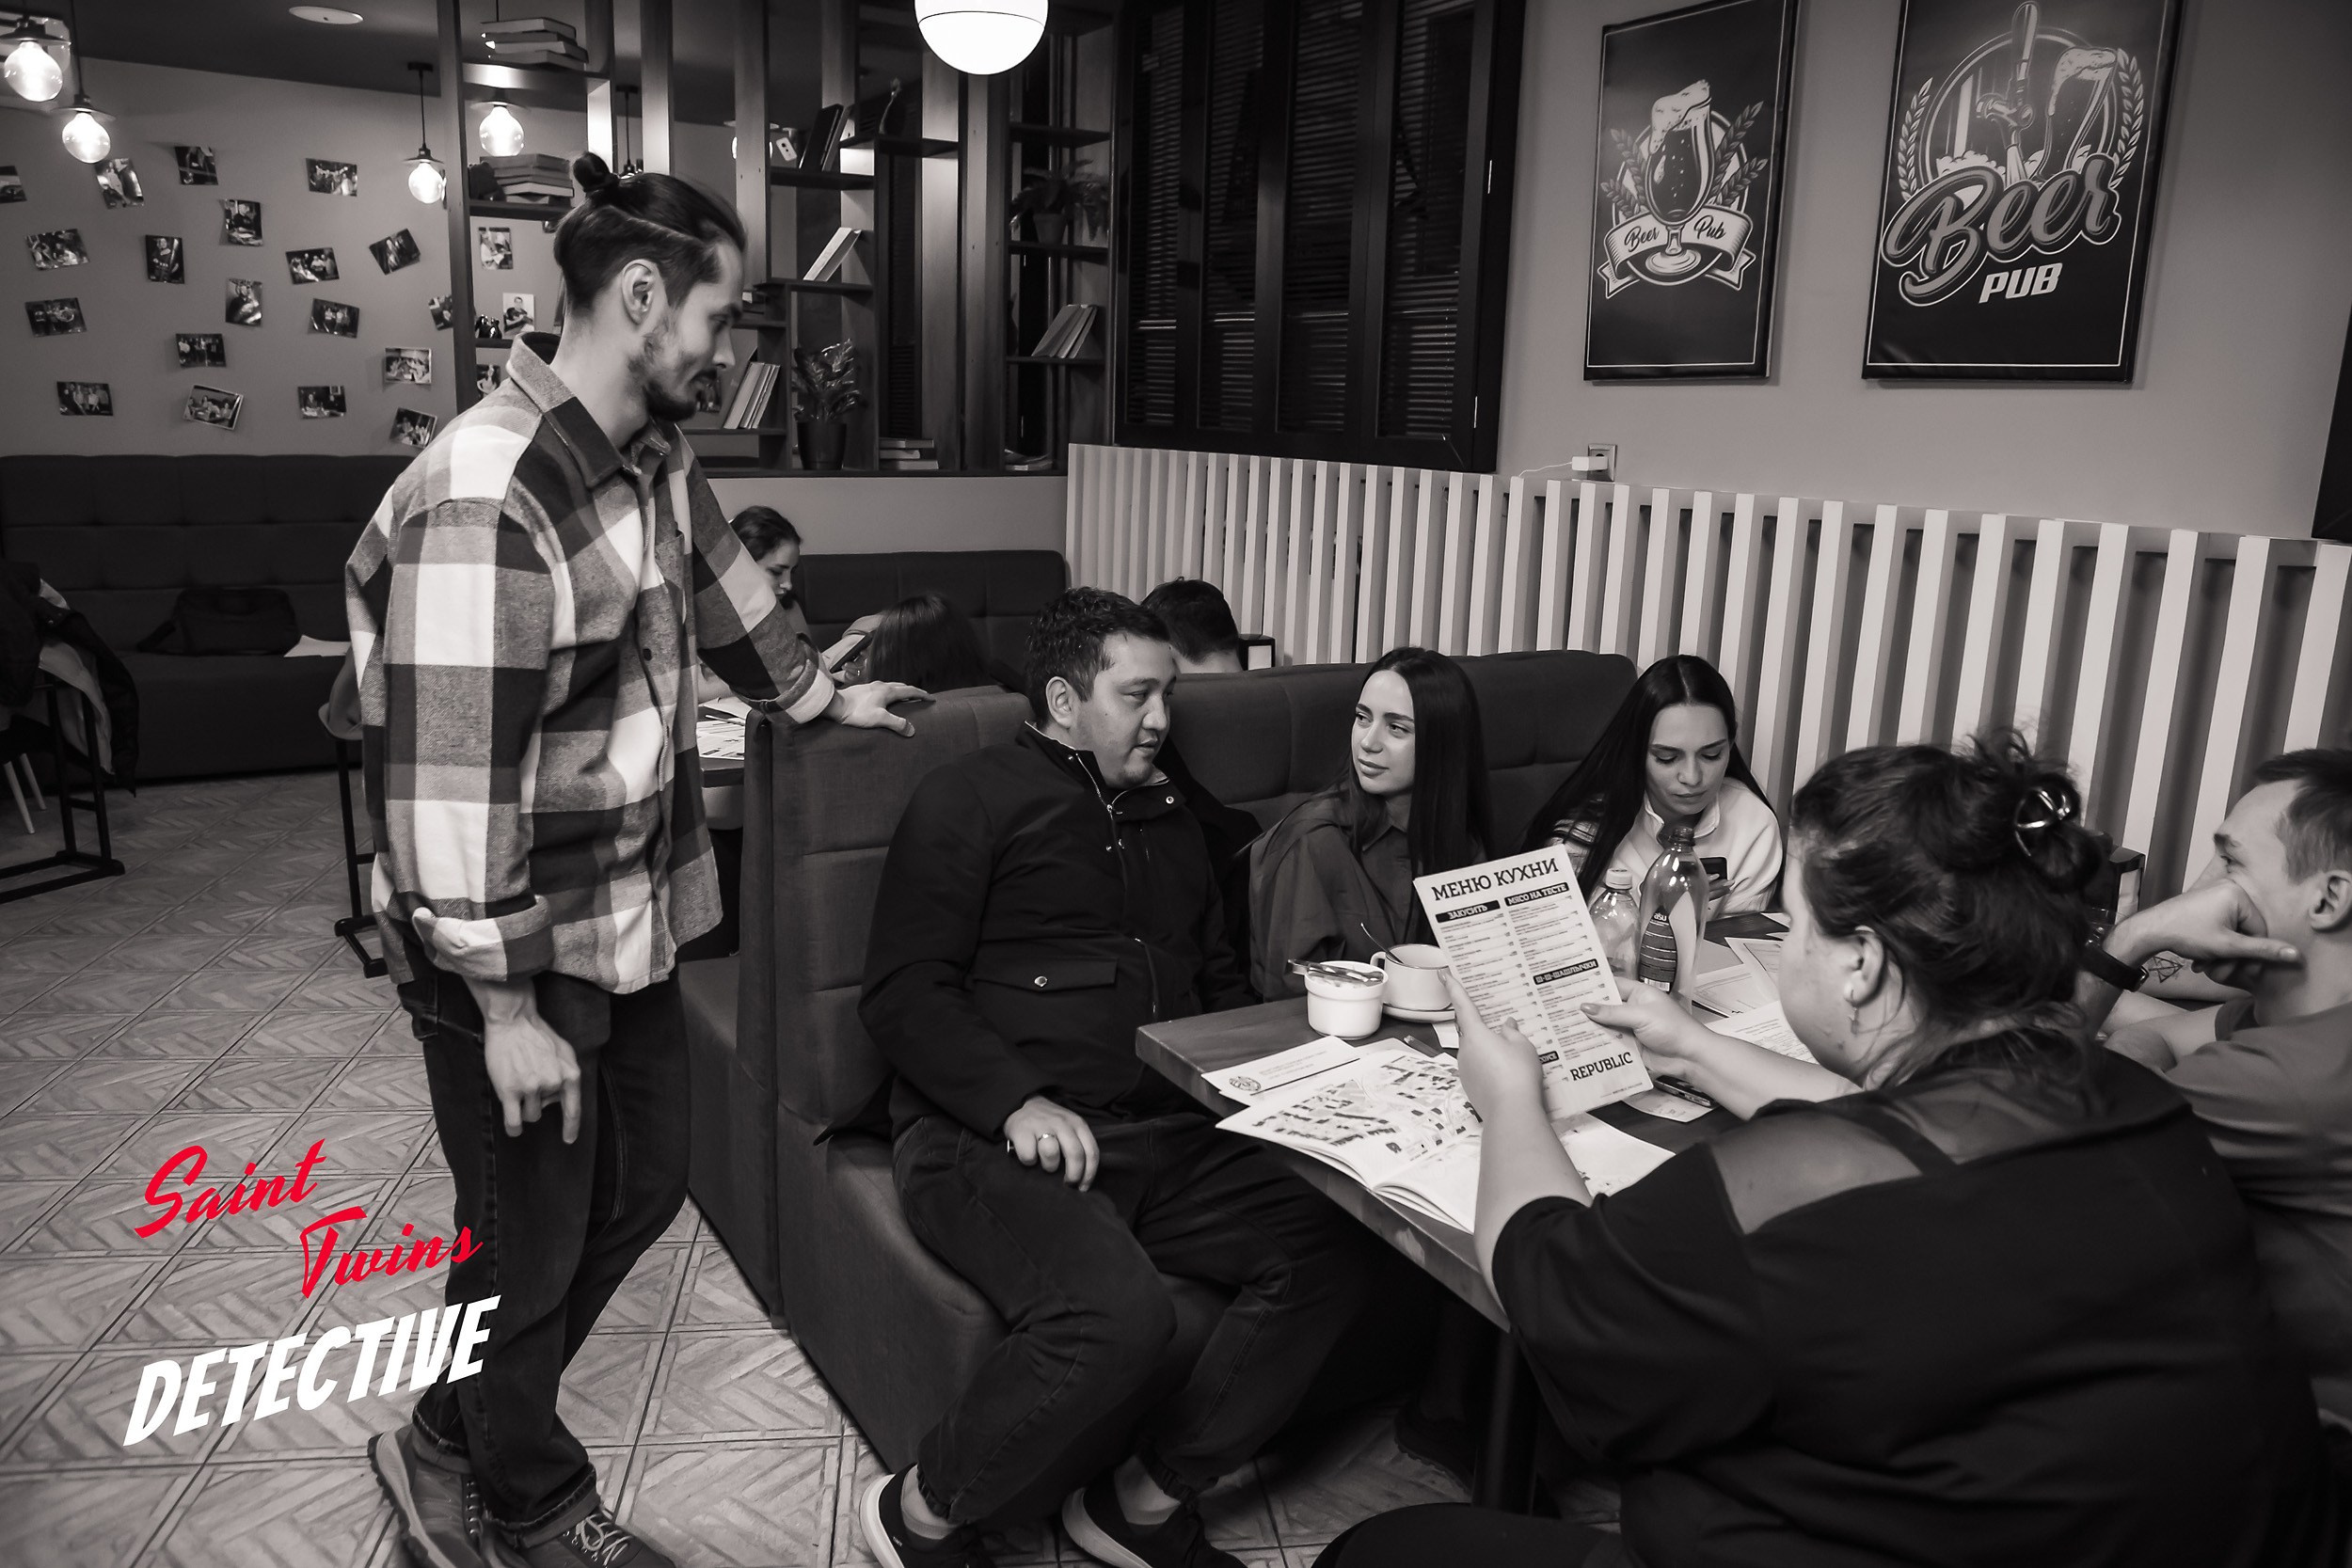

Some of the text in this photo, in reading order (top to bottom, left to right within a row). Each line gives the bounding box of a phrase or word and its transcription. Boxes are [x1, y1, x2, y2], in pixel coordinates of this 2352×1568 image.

[1624, 214, 1726, 252] Beer Pub
[1883, 154, 2120, 304] Beer
[1979, 262, 2063, 304] PUB
[1431, 858, 1559, 901] МЕНЮ КУХНИ
[1529, 891, 1542, 900] НА
[1541, 884, 1567, 896] ТЕСТЕ
[1570, 1052, 1633, 1081] REPUBLIC
